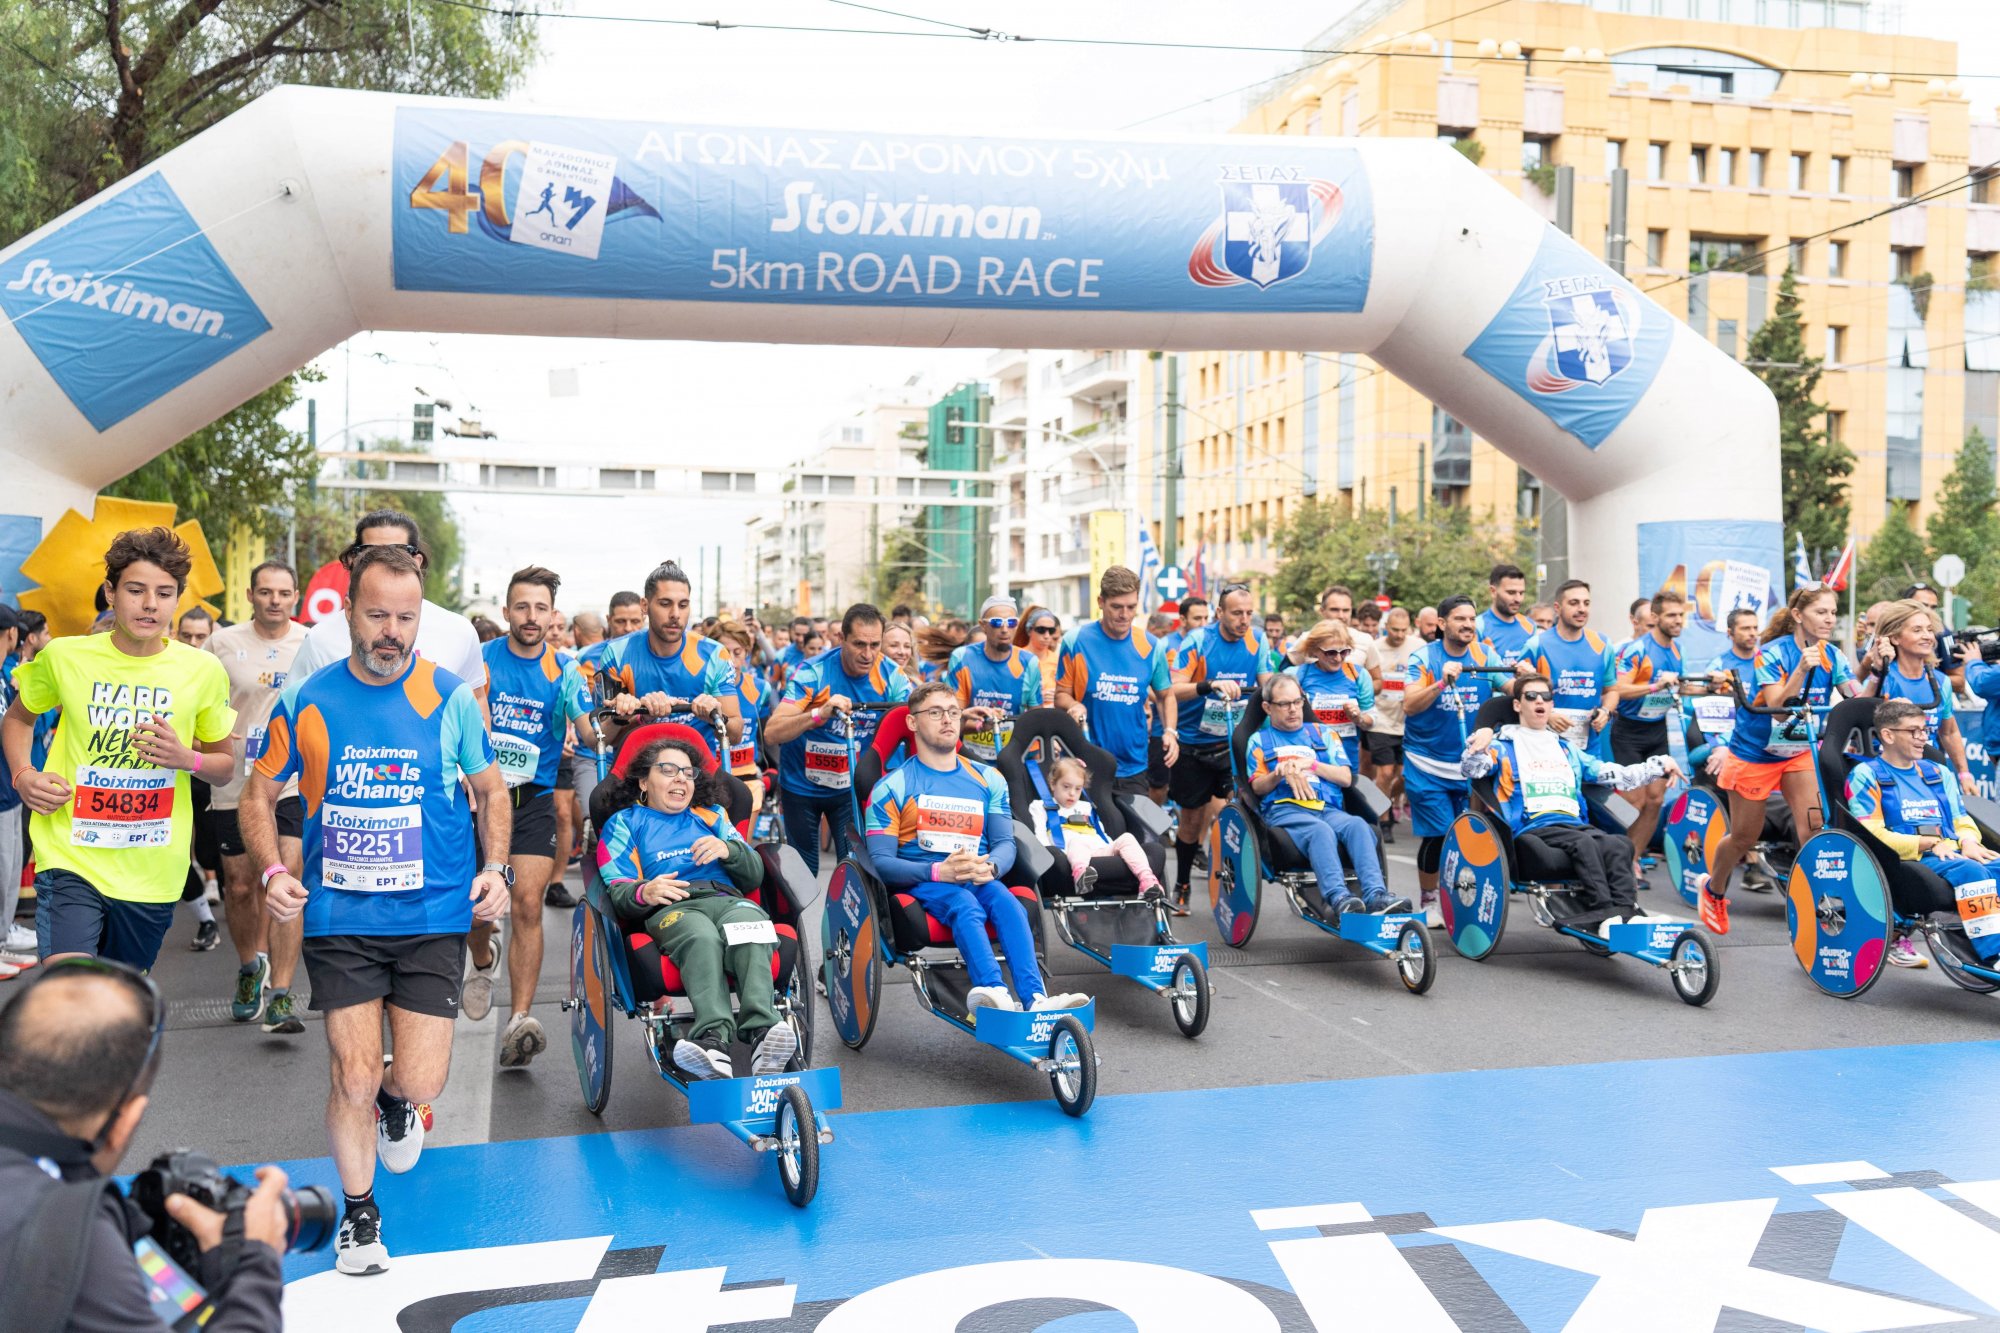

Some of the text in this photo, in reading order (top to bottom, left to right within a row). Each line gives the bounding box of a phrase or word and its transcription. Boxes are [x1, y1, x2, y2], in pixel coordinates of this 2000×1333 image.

[532, 146, 612, 169] ΜΑΡΑΘΩΝΙΟΣ
[636, 129, 1172, 189] ΑΓΩΝΑΣ ΔΡΟΜΟΥ 5χλμ
[545, 159, 594, 176] ΑΘΗΝΑΣ
[1218, 164, 1307, 182] ΣΕΓΑΣ
[770, 181, 1042, 241] Stoiximan
[709, 248, 1104, 299] 5km ROAD RACE
[5, 258, 225, 337] Stoiximan
[1099, 672, 1138, 684] Stoiximan
[1560, 669, 1594, 678] Stoiximan
[92, 682, 173, 708] HARD
[1096, 681, 1139, 694] Wheels
[496, 692, 544, 709] Stoiximan
[1098, 691, 1140, 706] Change
[491, 703, 543, 722] Wheels
[1319, 711, 1348, 721] 5549
[341, 745, 418, 760] Stoiximan
[490, 738, 532, 752] iximan
[810, 745, 848, 755] Stoixim
[495, 750, 527, 768] 529
[84, 771, 166, 788] Stoiximan
[336, 763, 421, 782] Wheels
[328, 780, 425, 803] of Change
[91, 792, 159, 814] 54834
[924, 798, 977, 812] Stoiximan
[327, 811, 410, 830] Stoiximan
[929, 812, 973, 830] 55524
[336, 831, 403, 856] 52251
[1154, 955, 1180, 966] Whe
[1156, 964, 1175, 973] Cha
[754, 1076, 800, 1088] Stoiximan
[746, 1101, 778, 1114] of Cha
